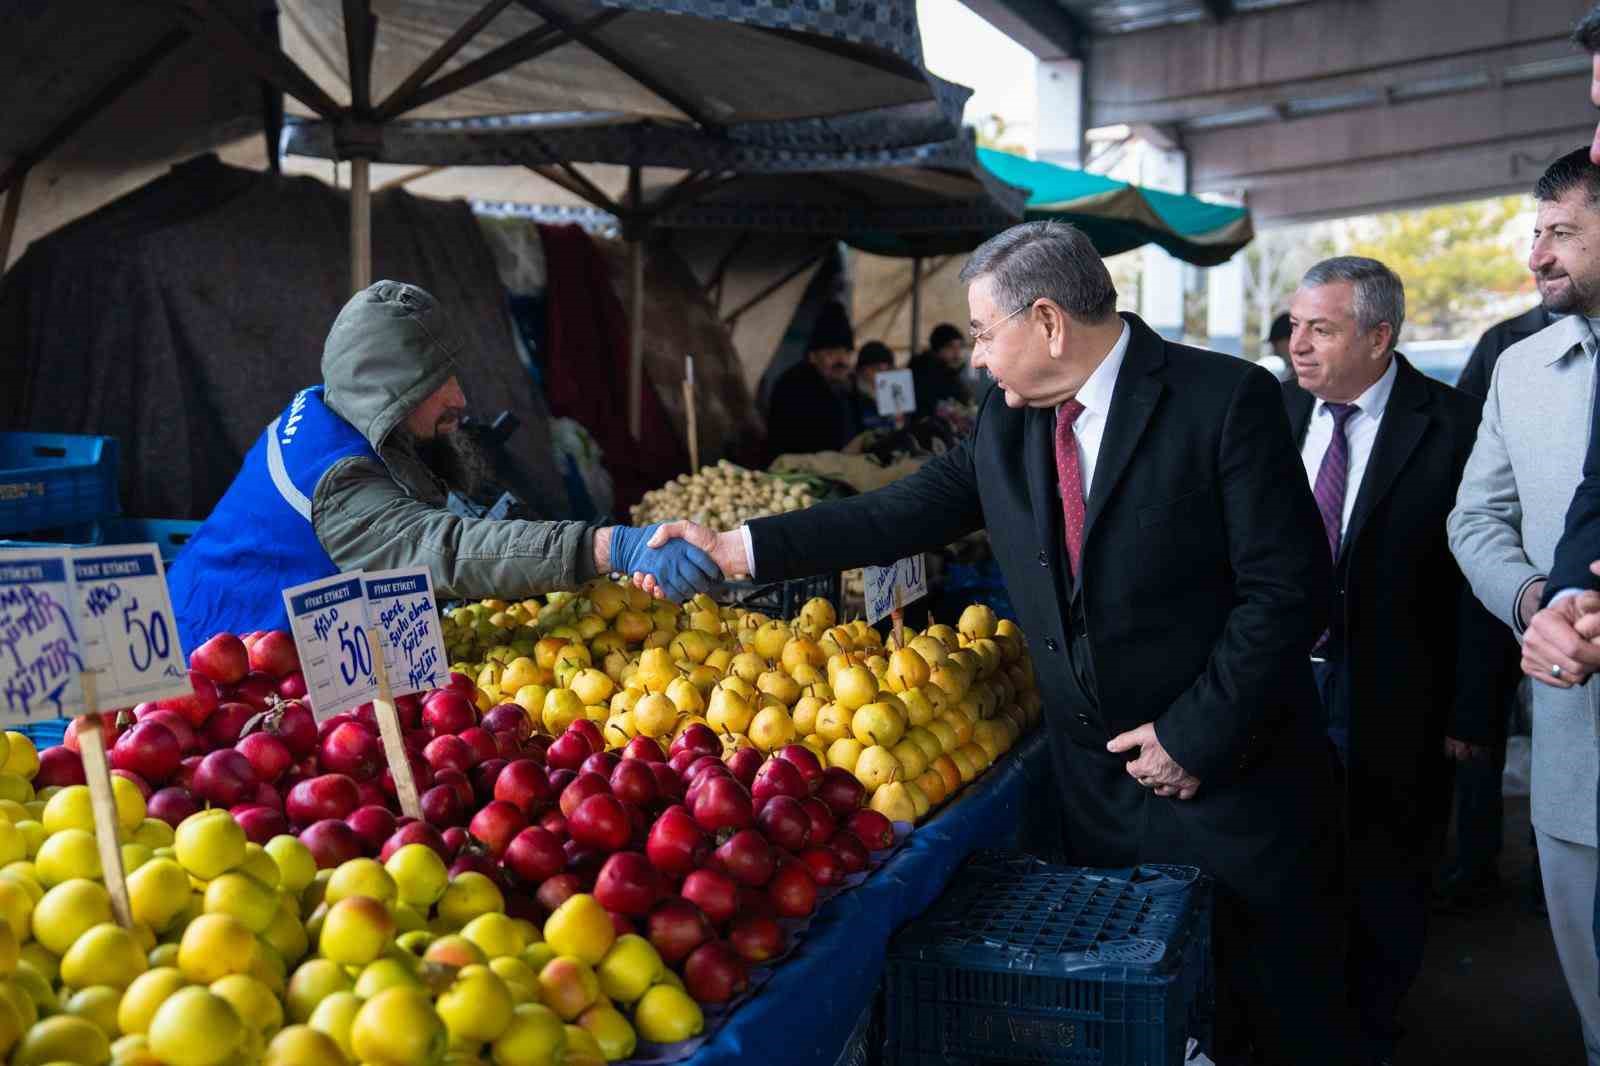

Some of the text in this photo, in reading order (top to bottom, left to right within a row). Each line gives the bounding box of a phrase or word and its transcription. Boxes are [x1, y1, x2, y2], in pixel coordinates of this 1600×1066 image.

[305, 587, 350, 609] FİYAT ETİKETİ
[374, 578, 417, 595] FİYAT ETİKETİ
[408, 597, 433, 622] elma
[124, 598, 169, 671] 50
[338, 621, 371, 686] 50
